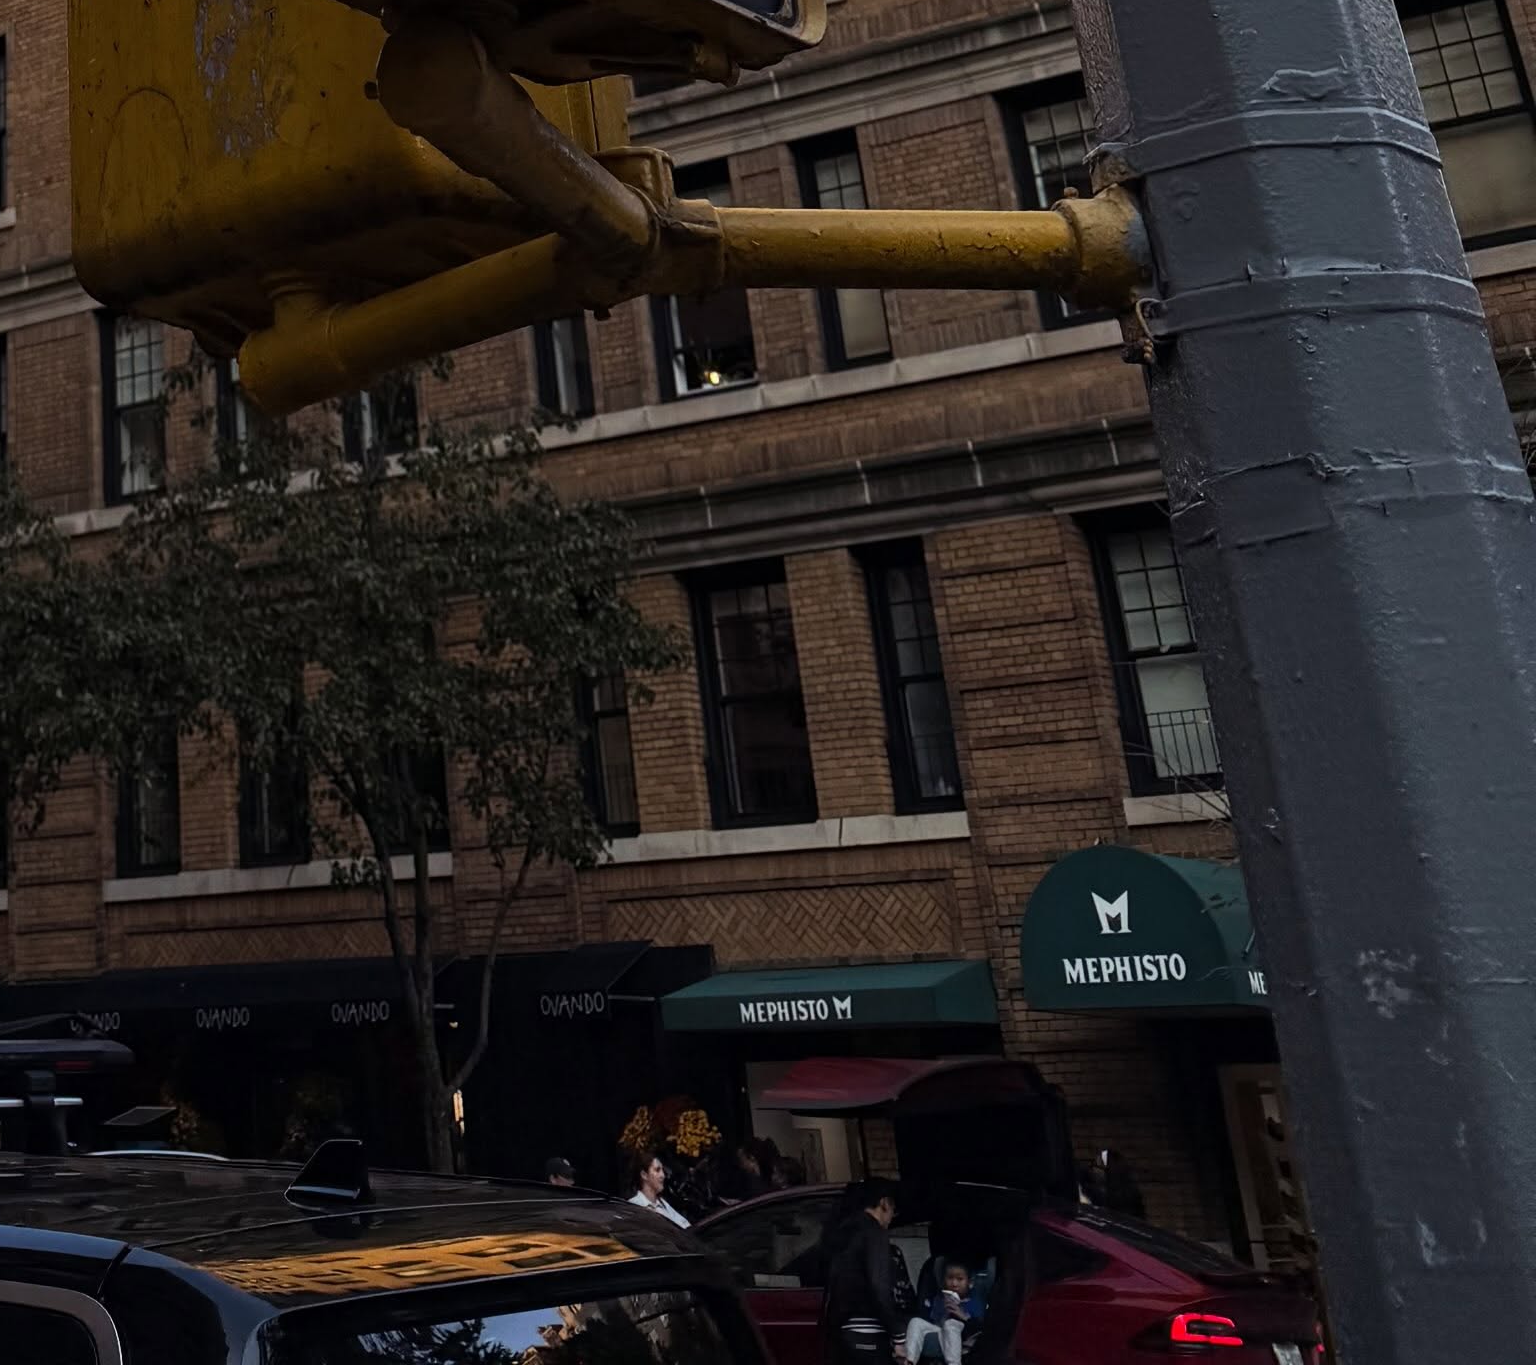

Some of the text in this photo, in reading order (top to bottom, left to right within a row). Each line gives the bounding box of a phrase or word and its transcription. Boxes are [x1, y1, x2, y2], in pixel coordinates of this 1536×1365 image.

[1062, 952, 1187, 986] MEPHISTO
[195, 1005, 251, 1029] OVANDO
[330, 1000, 391, 1026] OVANDO
[539, 991, 606, 1018] OVANDO
[739, 999, 829, 1024] MEPHISTO
